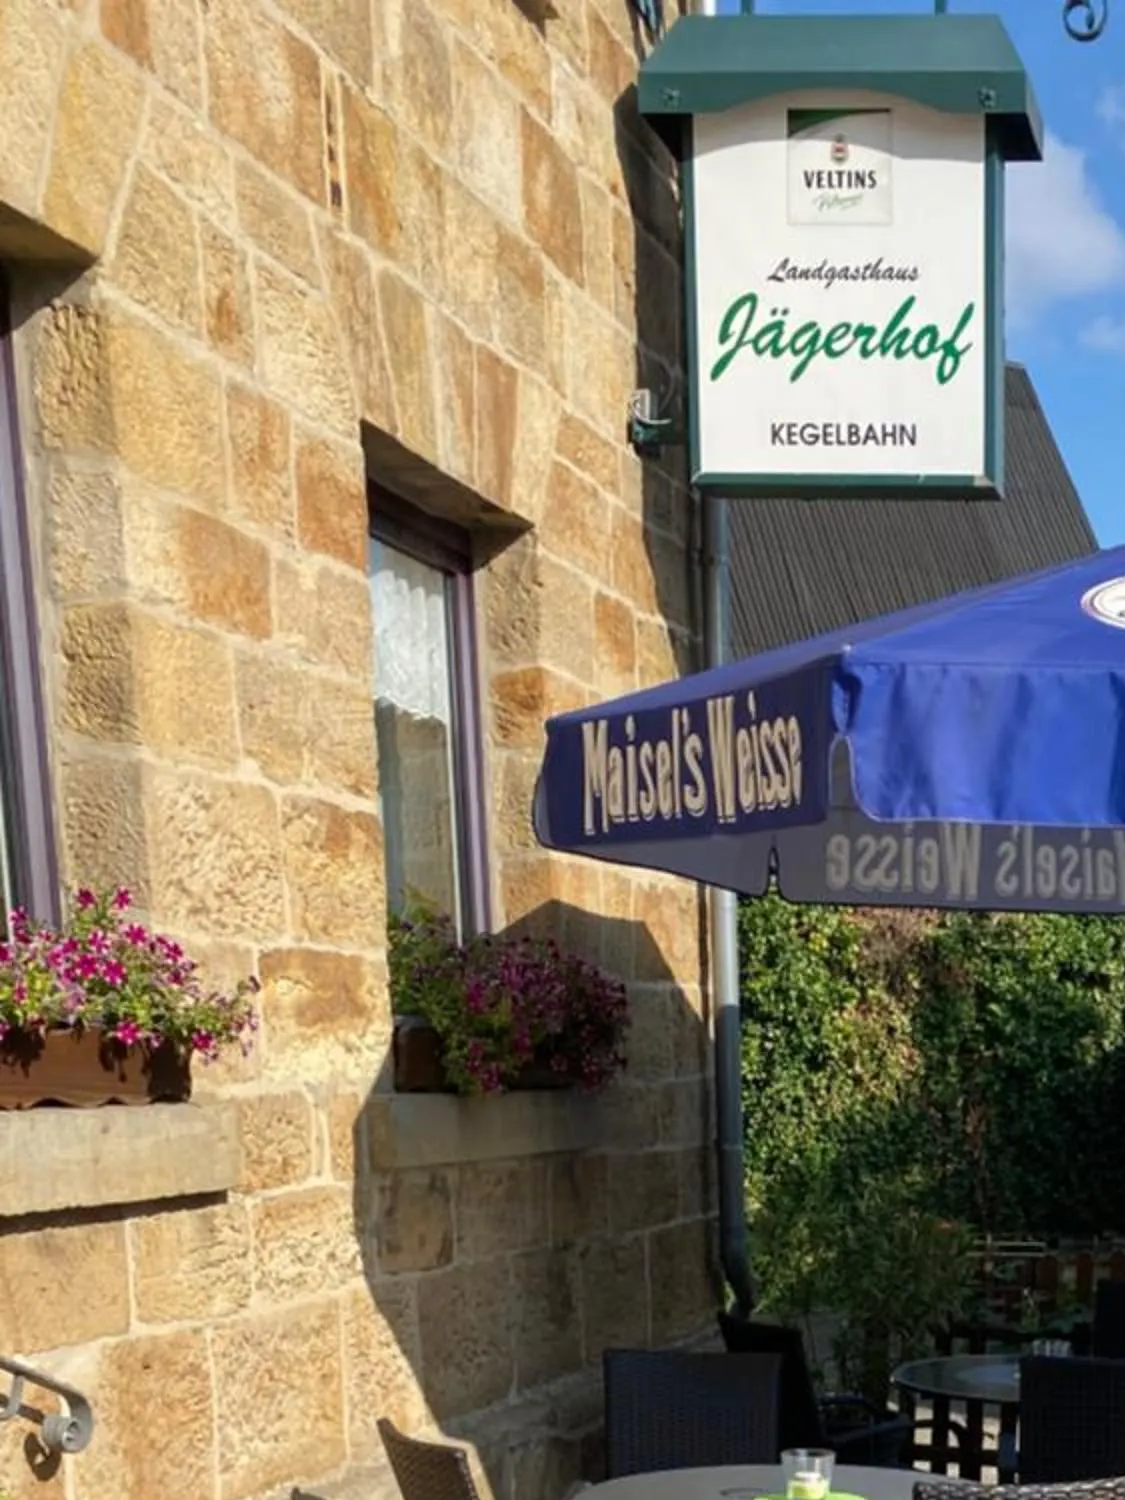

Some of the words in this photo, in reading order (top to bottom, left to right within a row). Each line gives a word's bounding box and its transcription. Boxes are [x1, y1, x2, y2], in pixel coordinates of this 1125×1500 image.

[803, 169, 877, 189] VELTINS
[767, 257, 919, 288] Landgasthaus
[710, 292, 975, 385] Jägerhof
[770, 422, 917, 447] KEGELBAHN
[582, 707, 705, 836] Maisel's
[706, 691, 801, 823] Weisse
